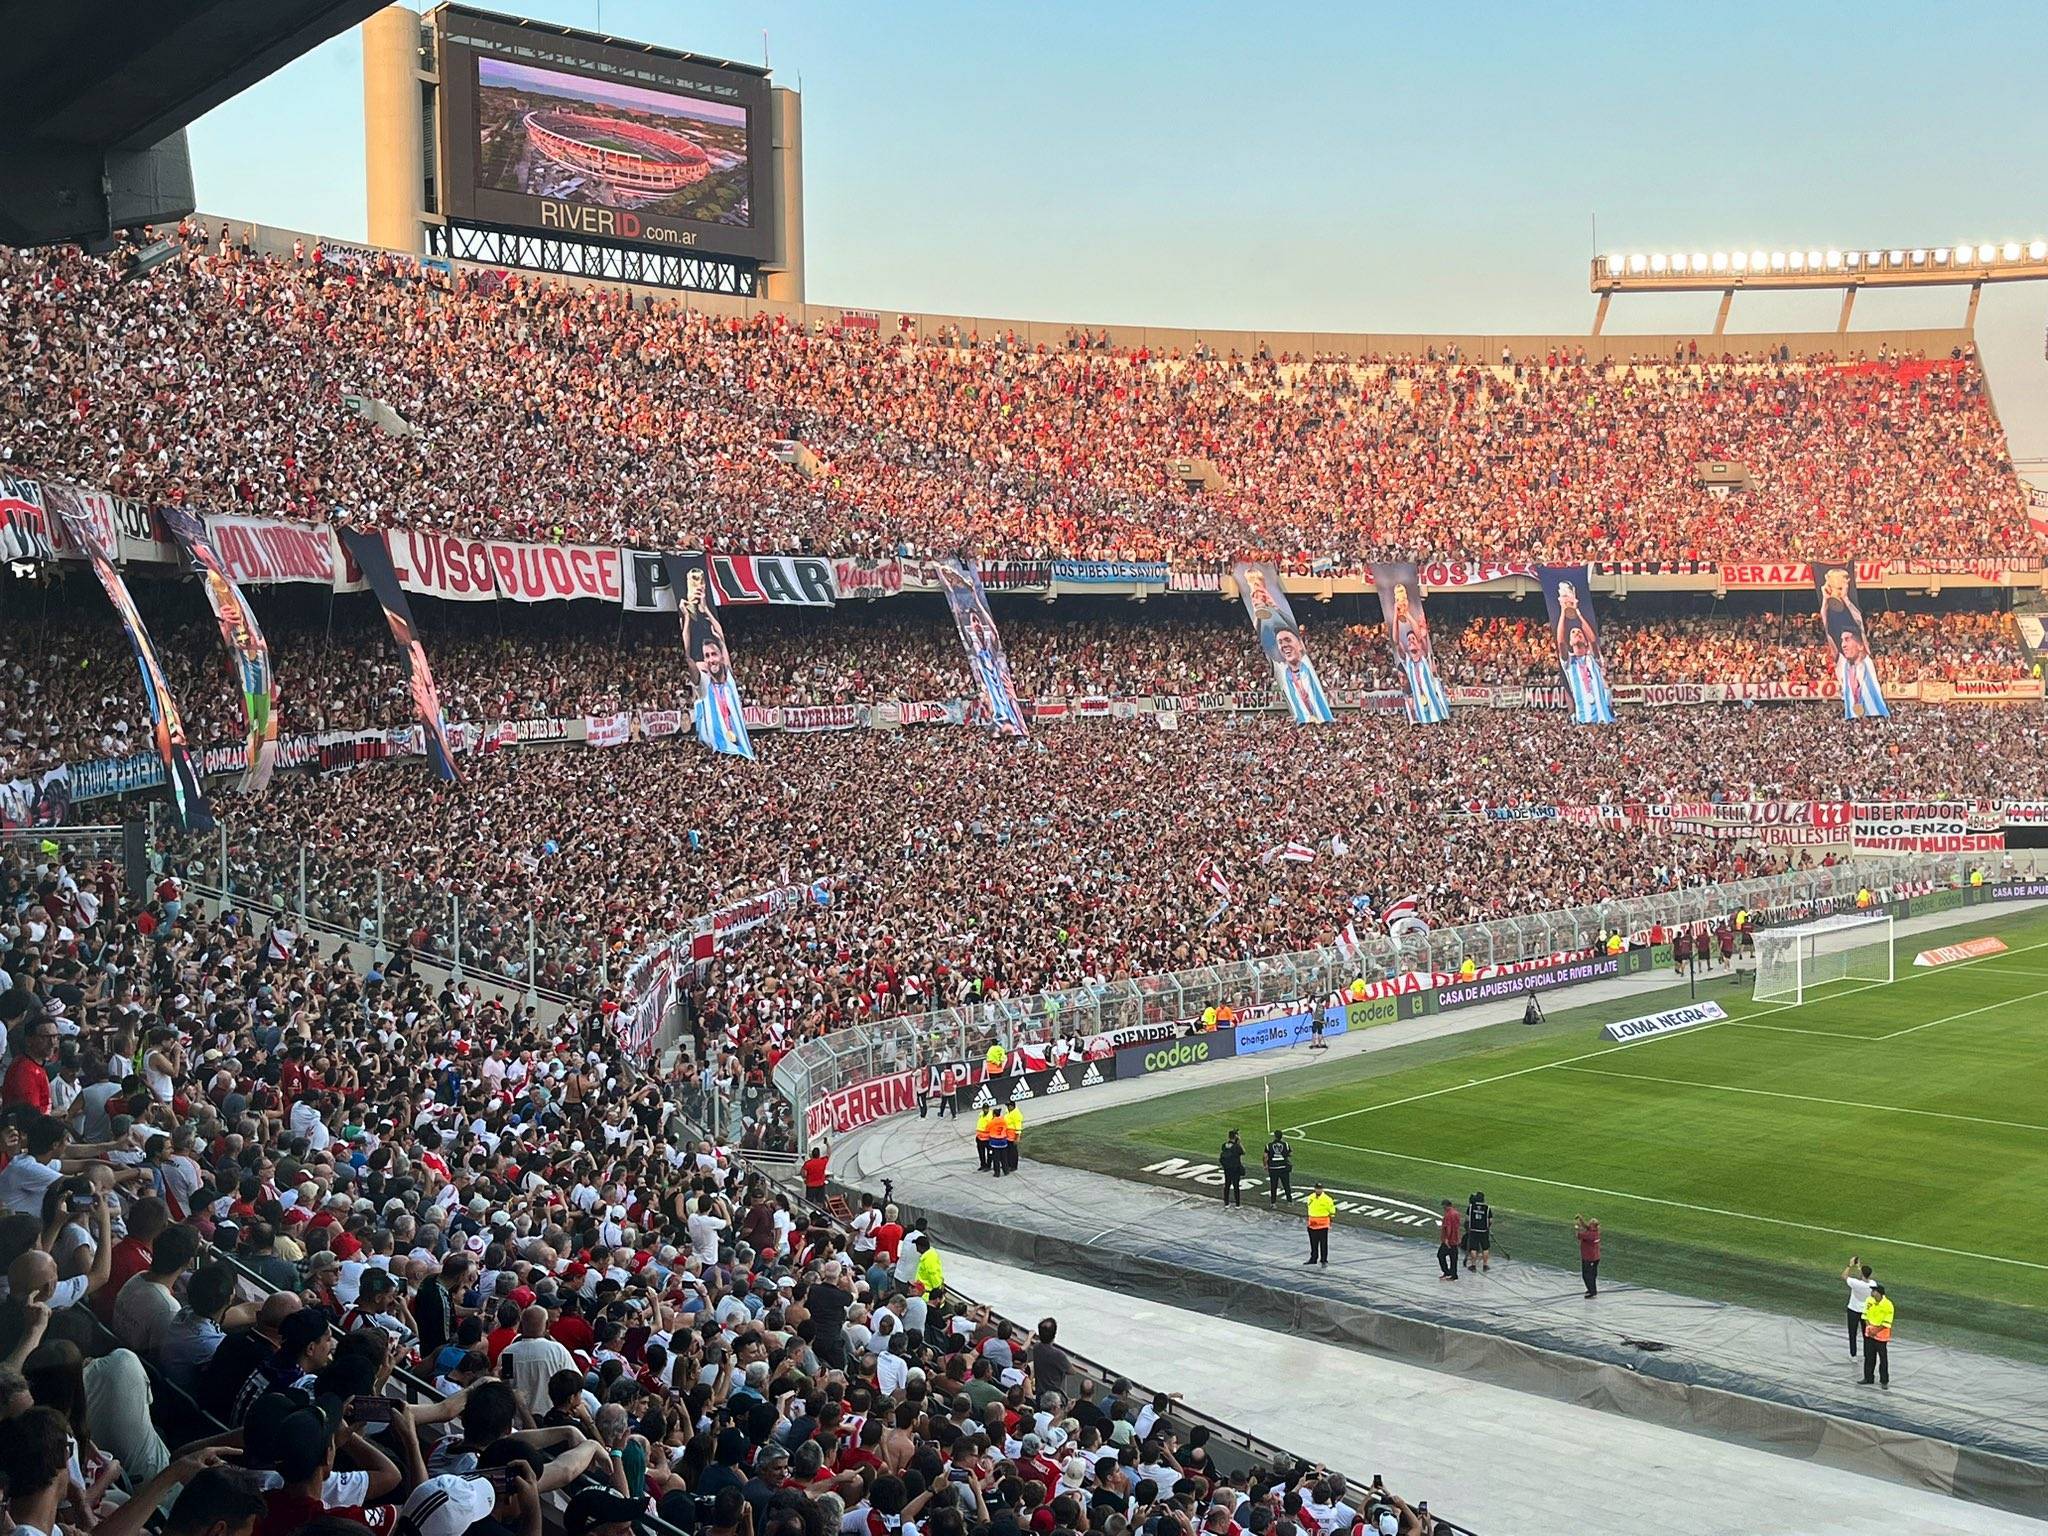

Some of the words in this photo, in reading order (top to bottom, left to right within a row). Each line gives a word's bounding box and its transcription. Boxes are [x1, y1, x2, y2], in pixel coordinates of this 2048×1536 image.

[541, 201, 641, 237] RIVERID
[642, 225, 697, 246] .com.ar
[491, 546, 619, 597] BUDGE
[634, 551, 835, 606] PLAR
[1053, 562, 1074, 578] LOS
[1078, 562, 1109, 579] PIBES
[1112, 562, 1127, 578] DE
[1129, 563, 1161, 579] SAVIO
[1723, 562, 1883, 584] BERAZAUI
[1644, 685, 1703, 702] NOGUES
[1724, 681, 1837, 699] ALMAGRO
[1153, 696, 1183, 711] VILLA
[1183, 697, 1197, 711] DE
[1197, 693, 1224, 709] MAYO
[784, 706, 855, 728] LAFERRERE
[1671, 804, 1713, 818] GARIN
[1749, 802, 1811, 824] LOLA
[1818, 804, 1844, 823] 77
[1854, 804, 1963, 821] LIBERTADOR
[1770, 825, 1850, 845] BALLESTER
[1855, 823, 1963, 836] NICO-ENZO
[1920, 832, 2005, 853] HUDSON
[1993, 886, 2012, 897] CASA
[2015, 886, 2026, 895] DE
[1439, 990, 1465, 1006] CASA
[1466, 987, 1478, 1000] DE
[1479, 978, 1524, 998] APUESTAS
[1524, 971, 1557, 989] OFICIAL
[1558, 969, 1569, 984] DE
[1570, 964, 1593, 981] RIVER
[1594, 959, 1618, 976] PLATE
[1351, 1003, 1394, 1025] codere
[1610, 1018, 1661, 1039] LOMA
[1656, 1008, 1708, 1028] NEGRA
[1113, 1022, 1175, 1048] SIEMPRE
[1145, 1041, 1209, 1071] codere
[1047, 1082, 1070, 1094] adidas
[1082, 1075, 1104, 1087] adidas
[831, 1074, 916, 1131] GARIN
[1009, 1090, 1034, 1102] adidas
